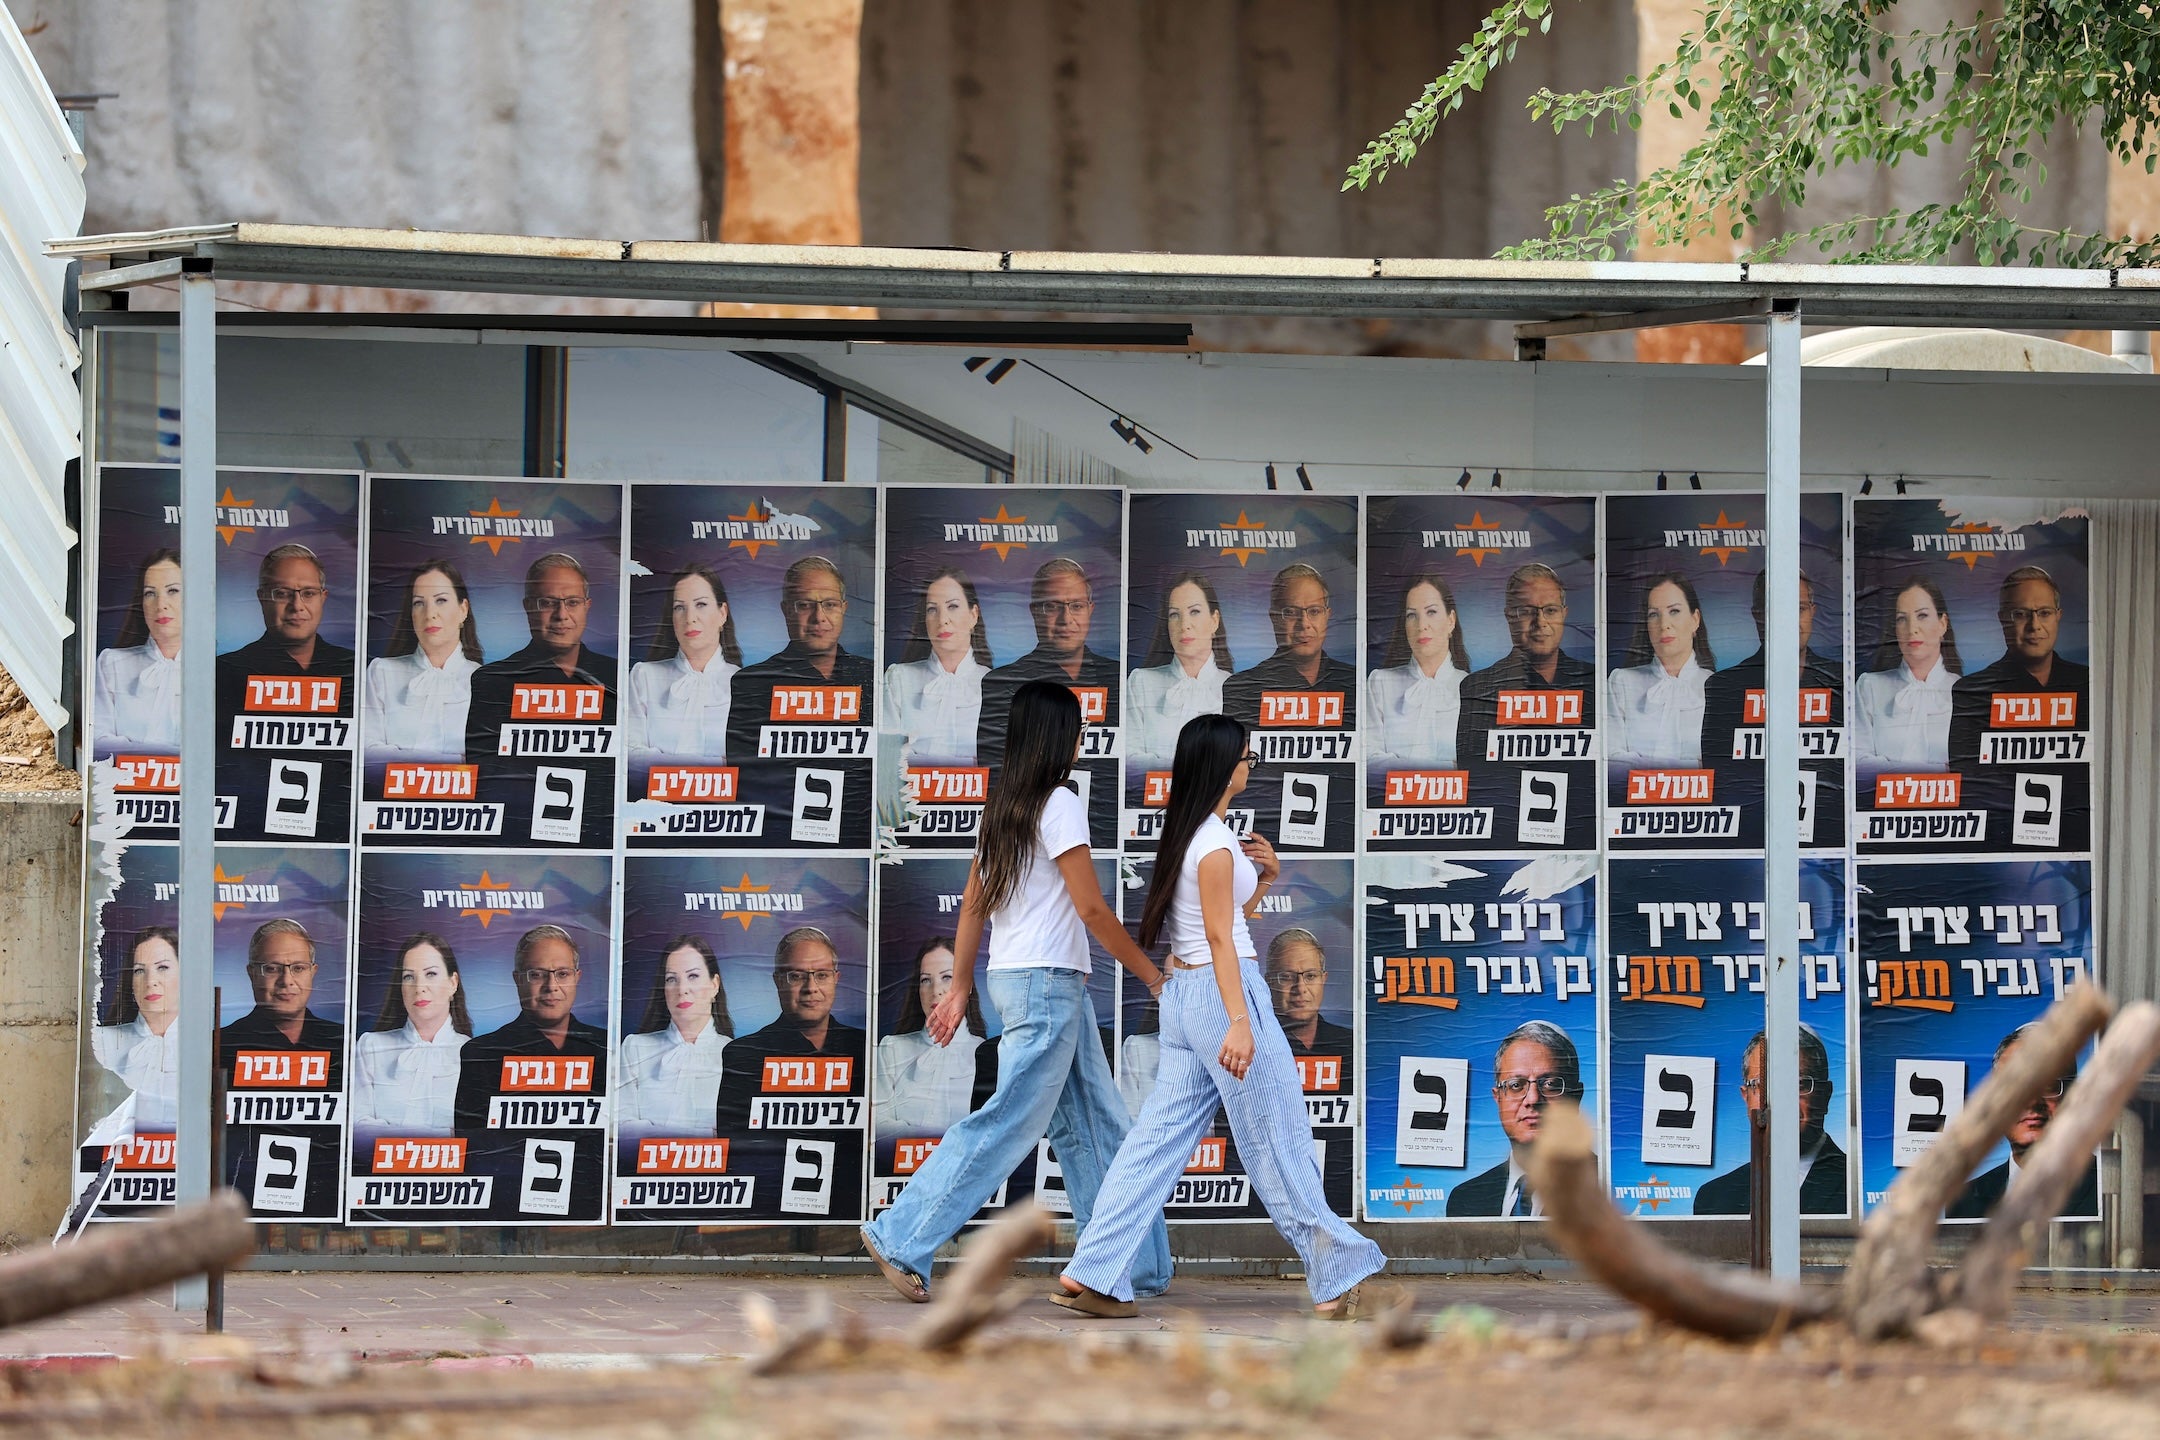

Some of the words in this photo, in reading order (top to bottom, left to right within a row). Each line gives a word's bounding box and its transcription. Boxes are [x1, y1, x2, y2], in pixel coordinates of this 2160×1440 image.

[229, 508, 289, 527] עוצמה
[432, 517, 490, 535] יהודית
[495, 519, 554, 536] עוצמה
[691, 522, 749, 539] יהודית
[944, 525, 998, 541] יהודית
[1003, 525, 1058, 542] עוצמה
[1186, 530, 1238, 547] יהודית
[1243, 531, 1296, 547] עוצמה
[1422, 531, 1474, 547] יהודית
[1478, 531, 1530, 547] עוצמה
[1664, 530, 1719, 547] יהודית
[1722, 529, 1767, 546] וצמה
[1913, 535, 1965, 551] יהודית
[1971, 534, 2025, 550] עוצמה
[249, 681, 300, 705] גביר
[311, 682, 335, 710] בן
[516, 689, 565, 713] גביר
[576, 690, 599, 718] בן
[774, 691, 823, 714] גביר
[834, 692, 856, 719] בן
[1081, 692, 1103, 717] בן
[1263, 696, 1309, 720] גביר
[1318, 696, 1340, 725] בן
[1500, 696, 1546, 718] גביר
[1556, 695, 1580, 719] בן
[1804, 693, 1828, 721] בן
[1994, 699, 2040, 721] גביר
[2051, 698, 2072, 725] בן
[236, 720, 348, 747] לביטחון.
[502, 727, 611, 755] לביטחון.
[762, 728, 868, 755] לביטחון.
[1490, 731, 1591, 758] לביטחון.
[1736, 729, 1840, 759] לביון.
[1259, 733, 1352, 763] לביטחון
[1983, 733, 2085, 761] לביטחון.
[119, 759, 180, 787] טליב
[388, 767, 470, 794] גוטליב
[652, 770, 732, 796] גוטליב
[1631, 773, 1708, 799] גוטליב
[1389, 774, 1462, 800] גוטליב
[1879, 777, 1955, 803] גוטליב
[370, 805, 496, 831] למשפטים.
[633, 807, 758, 832] למשפט.
[1373, 810, 1486, 835] למשפטים.
[1615, 808, 1733, 834] למשפטים.
[1863, 812, 1980, 838] למשפטים.
[218, 884, 279, 902] עוצמה
[423, 890, 481, 908] יהודית
[485, 891, 544, 909] עוצמה
[684, 893, 741, 910] יהודית
[745, 893, 803, 911] עוצמה
[1395, 904, 1474, 948] צריך
[1485, 903, 1564, 941] ביבי
[1637, 902, 1722, 947] צריך
[1732, 902, 1814, 940] בבי
[1886, 907, 1971, 952] צריך
[1979, 905, 2062, 943] ביבי
[1373, 955, 1454, 999] חזק!
[1466, 957, 1541, 993] גביר
[1553, 957, 1591, 1000] בן
[1616, 955, 1701, 1000] חזק!
[1712, 955, 1765, 992] ביר
[1802, 955, 1841, 1000] בן
[1866, 960, 1950, 1005] חזק!
[1961, 958, 2039, 996] גביר
[238, 1055, 291, 1081] גביר
[300, 1056, 325, 1085] בן
[505, 1061, 555, 1085] גביר
[565, 1062, 589, 1090] בן
[766, 1062, 815, 1085] גביר
[825, 1062, 848, 1090] בן
[1314, 1061, 1337, 1089] בן
[1411, 1070, 1449, 1130] ב
[1656, 1067, 1696, 1129] ב
[492, 1099, 601, 1127] לביטחון.
[753, 1099, 860, 1127] לביטחון.
[377, 1141, 459, 1168] גוטליב
[642, 1142, 722, 1168] גוטליב
[358, 1179, 485, 1204] למשפטים.
[623, 1179, 747, 1204] למשפטים.
[1369, 1188, 1406, 1201] יהודית
[1407, 1189, 1445, 1201] עוצמה
[1615, 1186, 1652, 1199] יהודית
[1654, 1186, 1692, 1199] עוצמה
